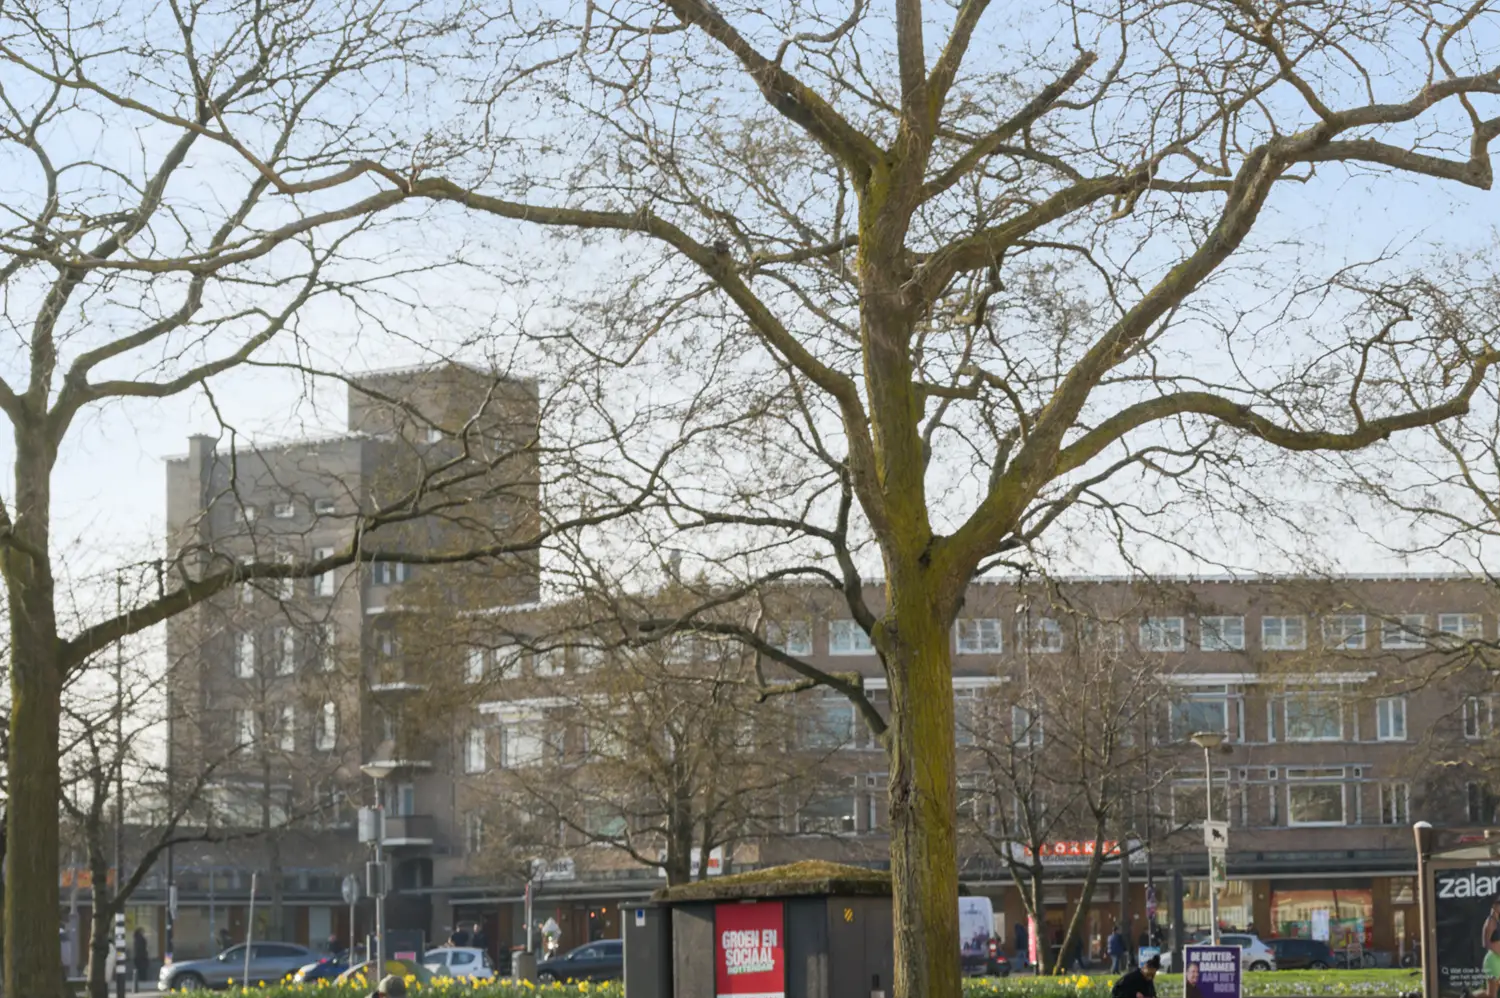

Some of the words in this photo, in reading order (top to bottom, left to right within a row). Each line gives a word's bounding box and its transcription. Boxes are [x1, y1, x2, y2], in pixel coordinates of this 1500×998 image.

[722, 930, 759, 949] GROEN
[762, 929, 777, 948] EN
[725, 947, 772, 967] SOCIAAL
[1190, 951, 1200, 961] DE
[1202, 951, 1236, 961] ROTTER-
[1200, 962, 1236, 972] DAMMER
